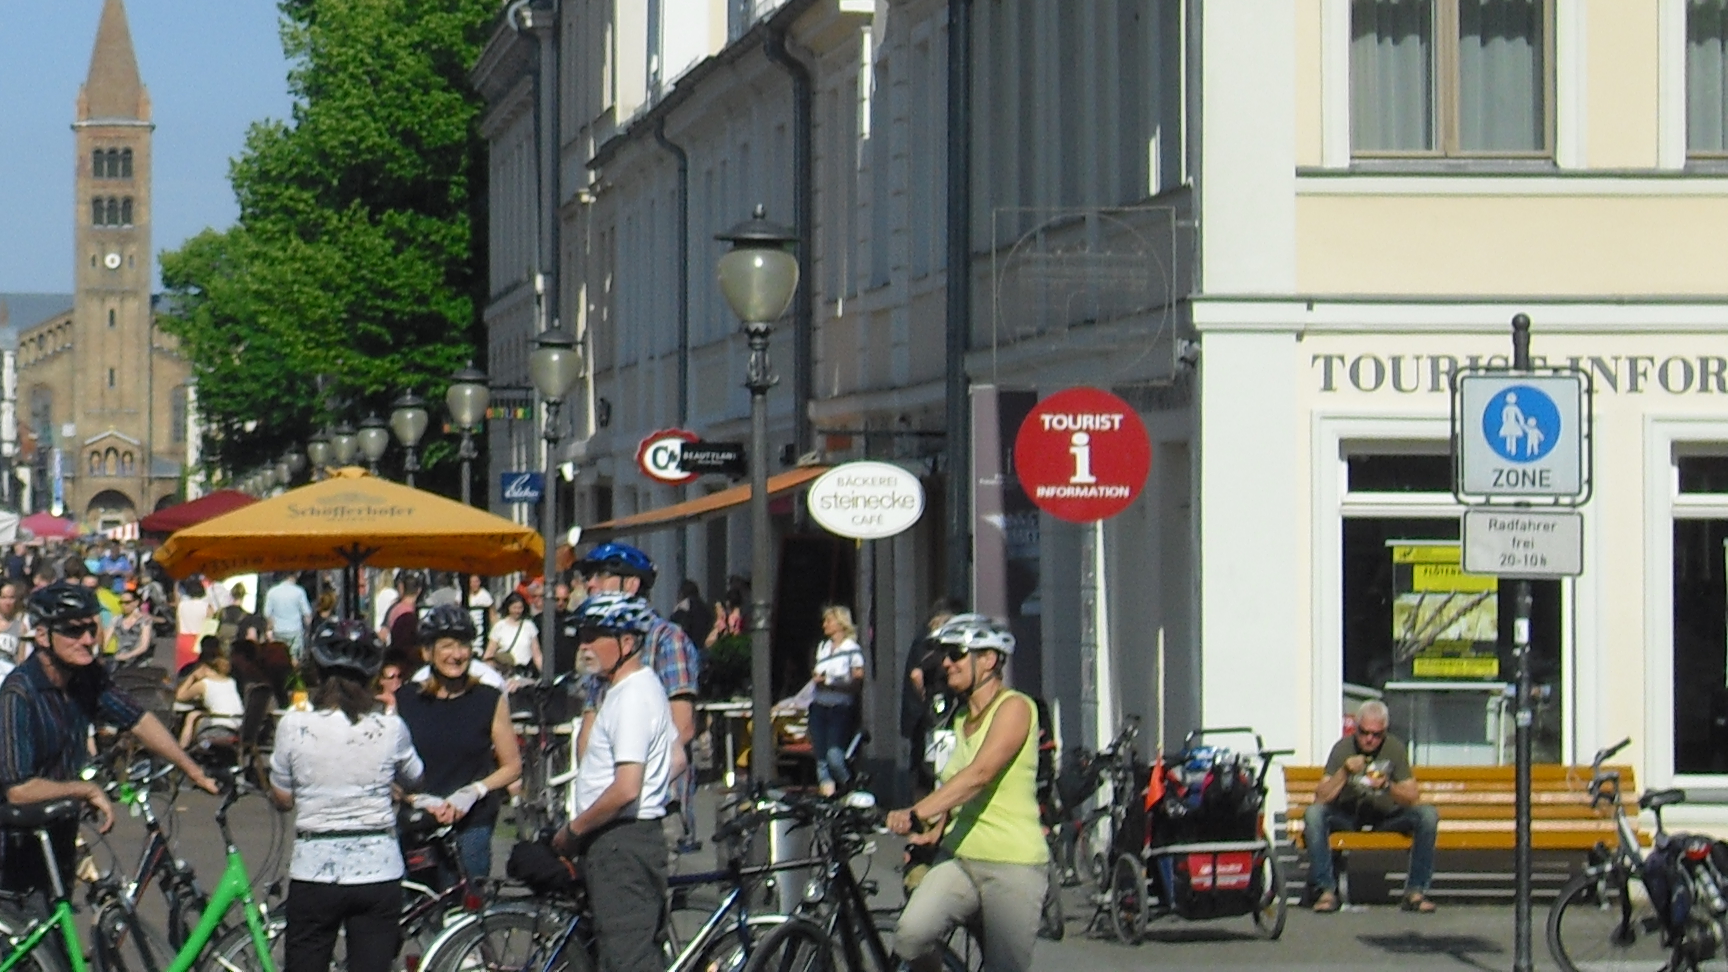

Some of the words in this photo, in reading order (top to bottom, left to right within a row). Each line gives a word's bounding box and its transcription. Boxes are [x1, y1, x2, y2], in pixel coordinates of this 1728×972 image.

[1311, 353, 1547, 394] TOUR
[1040, 413, 1124, 431] TOURIST
[836, 475, 898, 487] BÄCKEREI
[1492, 468, 1552, 488] ZONE
[1036, 485, 1130, 498] INFORMATION
[820, 491, 915, 510] steinecke
[851, 513, 885, 526] CAFÉ
[1488, 517, 1557, 532] Radfahrer
[1512, 536, 1535, 549] frei
